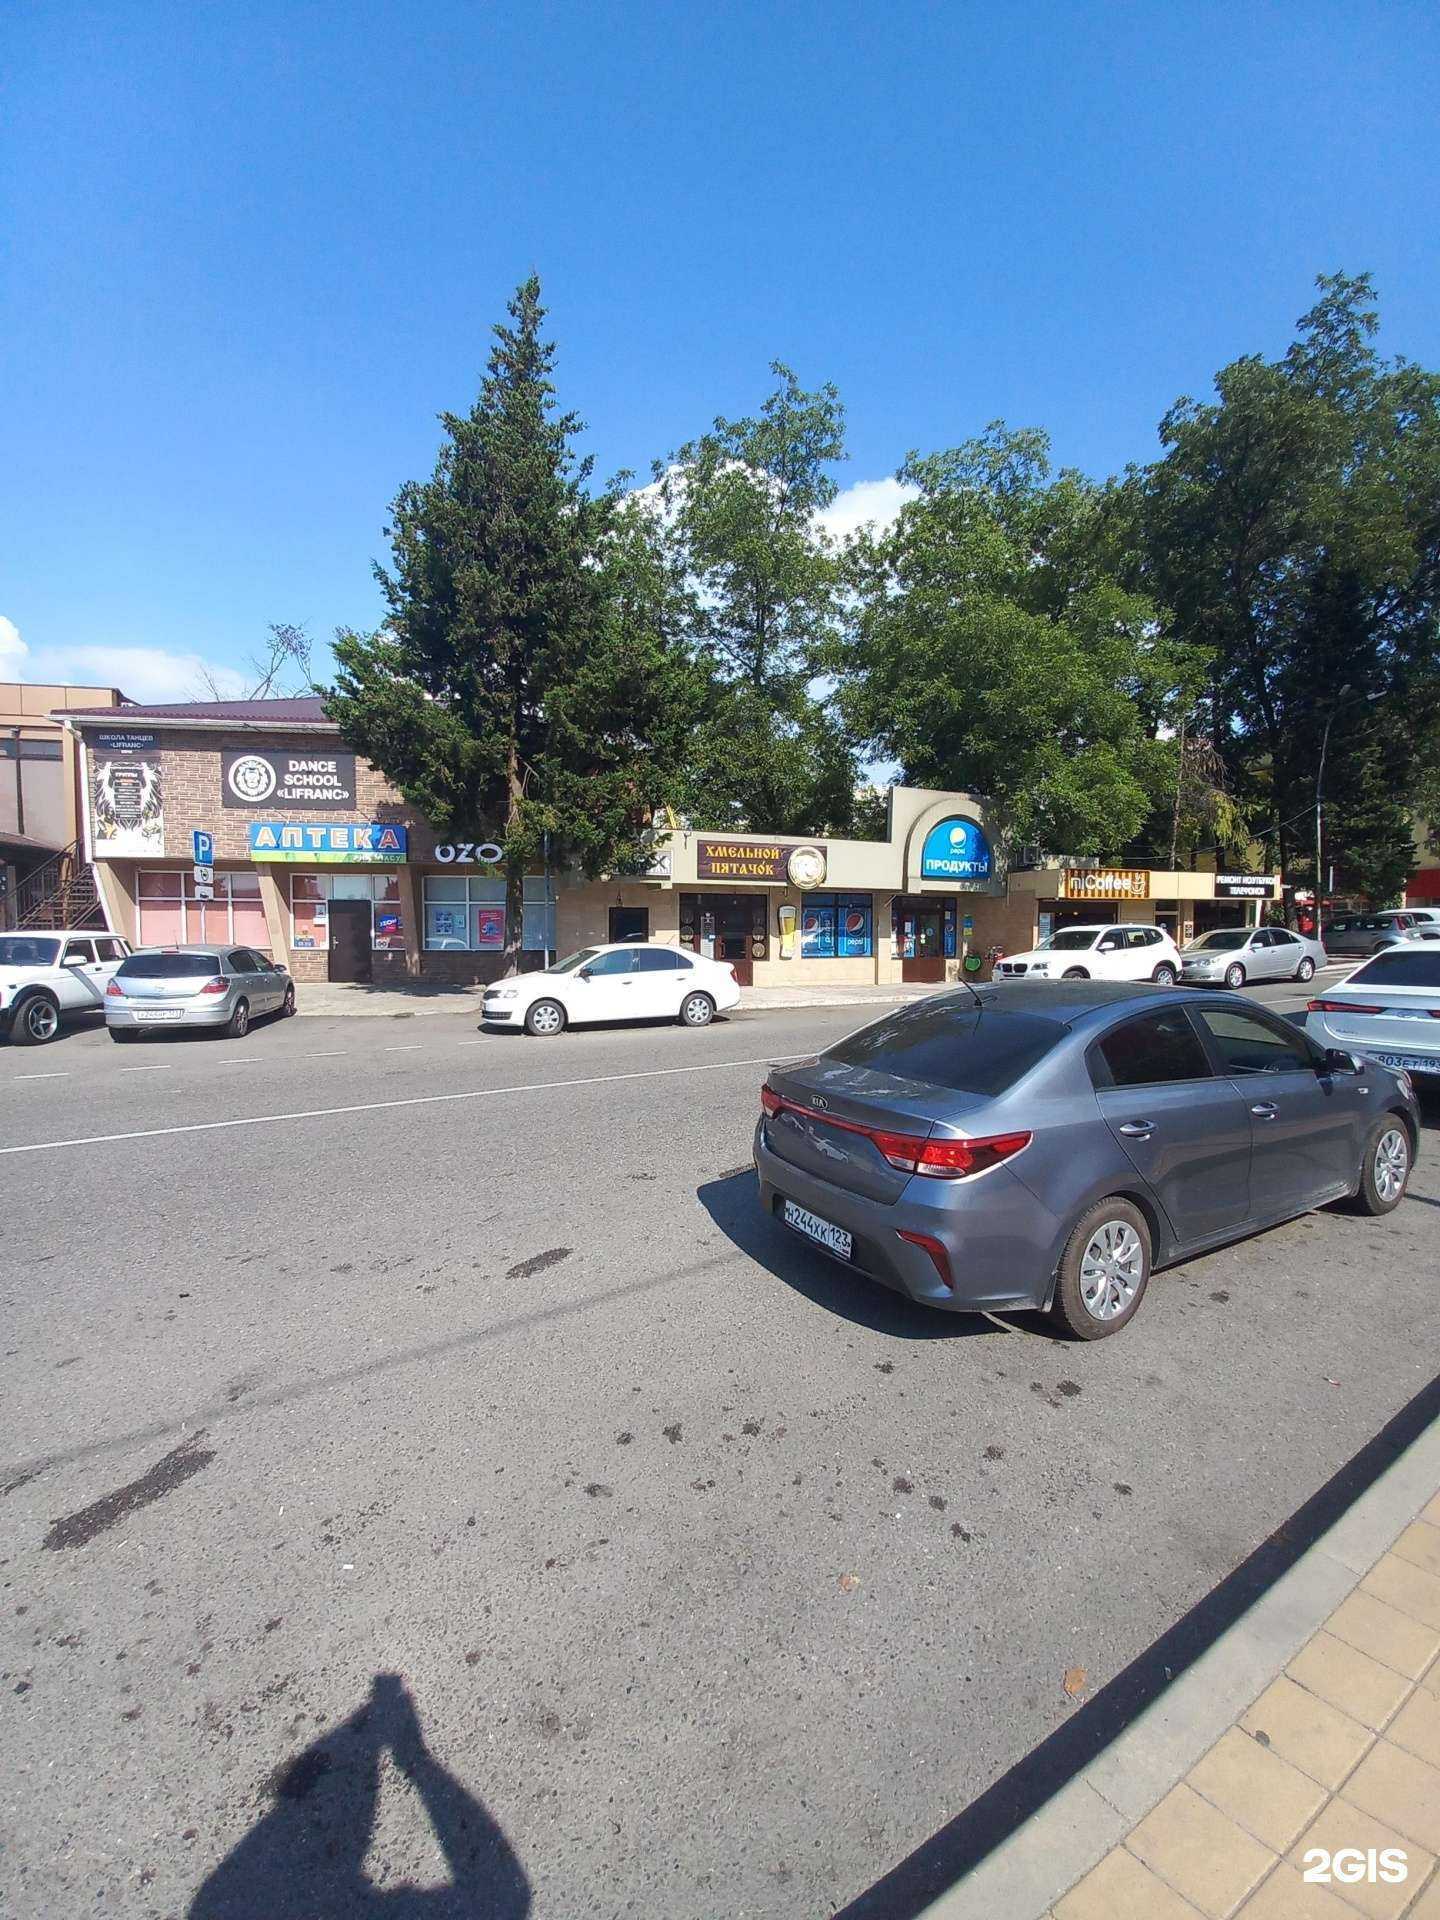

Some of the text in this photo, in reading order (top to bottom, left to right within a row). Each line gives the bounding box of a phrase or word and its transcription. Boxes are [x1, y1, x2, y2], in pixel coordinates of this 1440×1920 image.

[288, 760, 337, 773] DANCE
[284, 774, 342, 787] SCHOOL
[276, 788, 350, 800] «LIFRANC»
[254, 827, 400, 849] АПТЕКА
[706, 845, 780, 860] ХМЕЛЬНОЙ
[710, 861, 774, 876] ПЯТАЧОК
[926, 859, 988, 873] ПРОДУКТЫ
[847, 937, 864, 946] pepsi
[830, 1227, 848, 1247] 123
